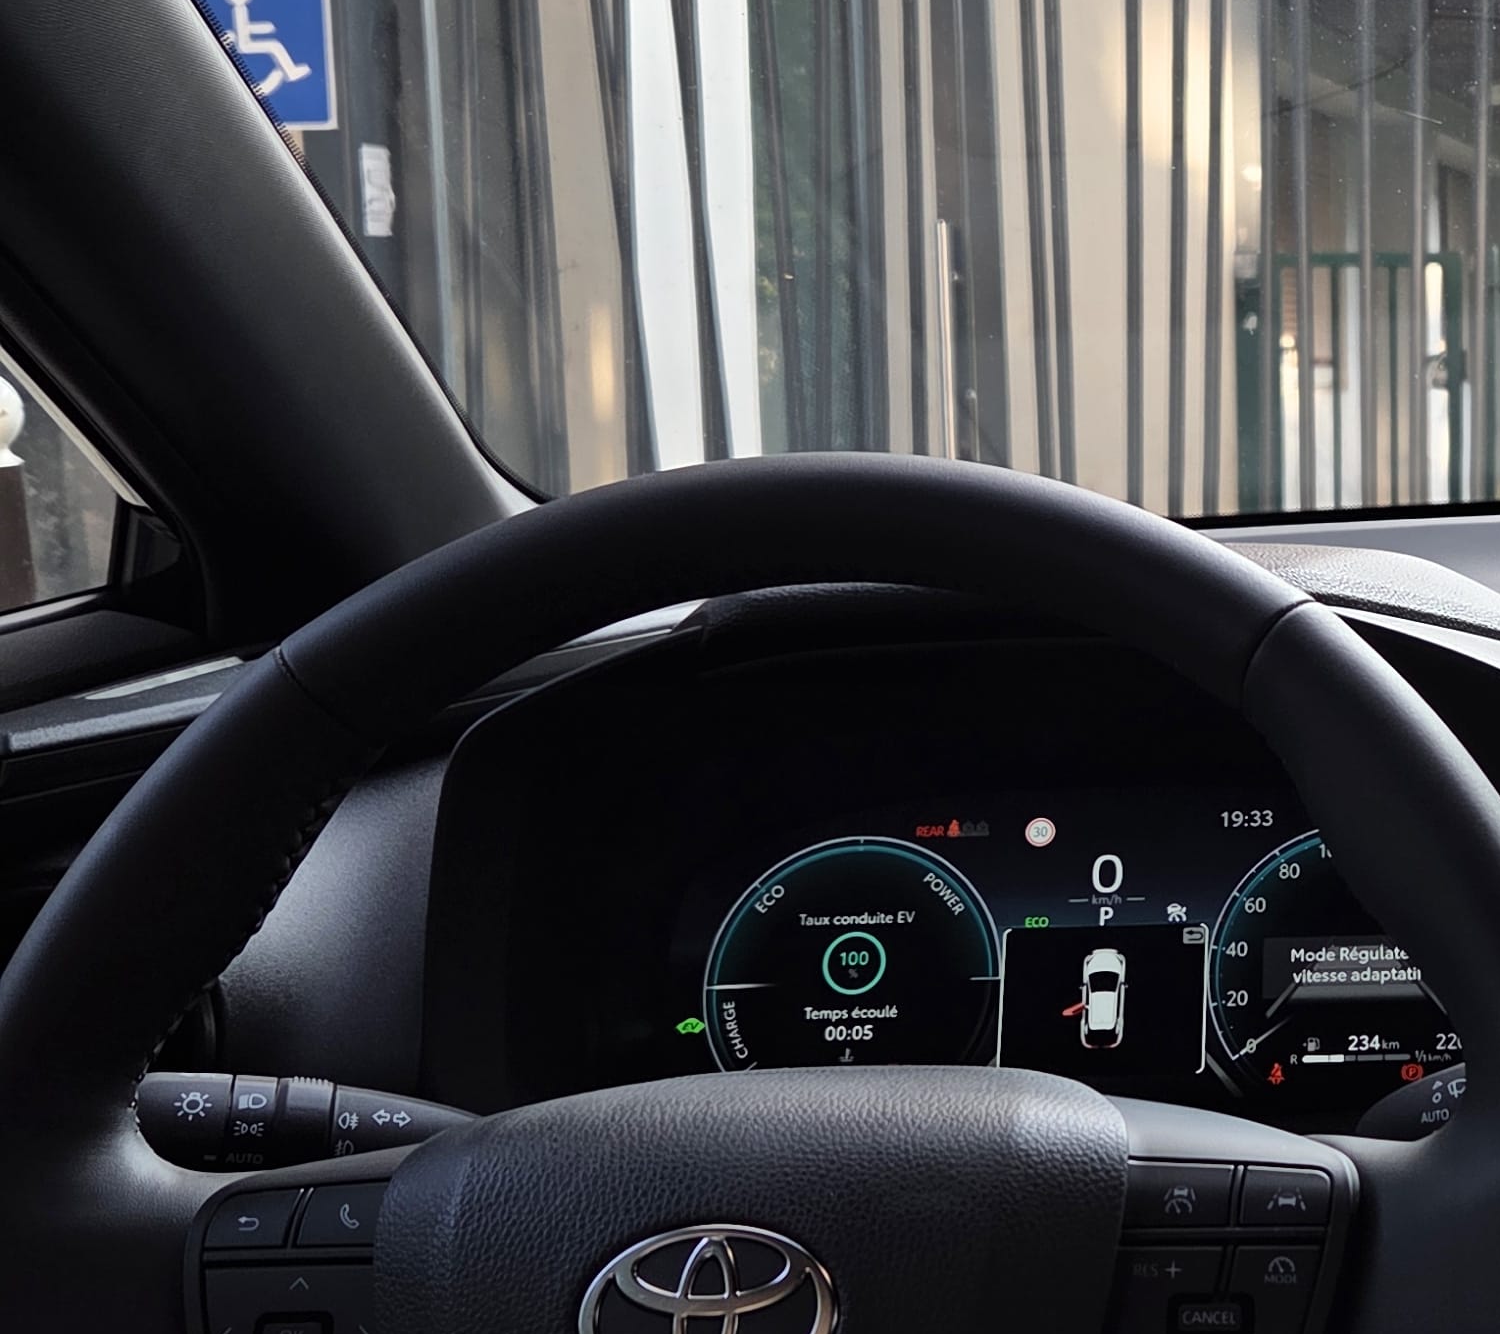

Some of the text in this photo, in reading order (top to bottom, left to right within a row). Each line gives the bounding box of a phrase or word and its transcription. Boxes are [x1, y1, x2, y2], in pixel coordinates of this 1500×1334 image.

[1220, 810, 1274, 828] 19:33
[915, 825, 944, 837] REAR
[1032, 826, 1048, 837] 30
[1091, 854, 1124, 893] 0
[1278, 863, 1300, 879] 80
[754, 884, 785, 914] ECO
[922, 872, 965, 916] POWER
[1091, 894, 1122, 905] km/h
[1244, 897, 1266, 913] 60
[799, 911, 915, 926] Taux conduite EV
[1024, 917, 1049, 928] ECO
[1099, 907, 1114, 926] P
[1225, 941, 1248, 957] 40
[1290, 948, 1336, 963] Mode
[839, 951, 869, 966] 100
[1292, 969, 1347, 983] vitesse
[1226, 990, 1248, 1007] 20
[804, 1005, 898, 1022] Temps écoulé
[722, 1001, 748, 1059] CHARGE
[824, 1025, 874, 1041] 00:05
[1348, 1034, 1400, 1051] 234 km
[1435, 1033, 1463, 1050] 22
[1289, 1055, 1298, 1065] R
[1420, 1108, 1450, 1123] AUTO
[225, 1151, 264, 1165] AUTO
[1181, 1310, 1236, 1325] CANCEL
